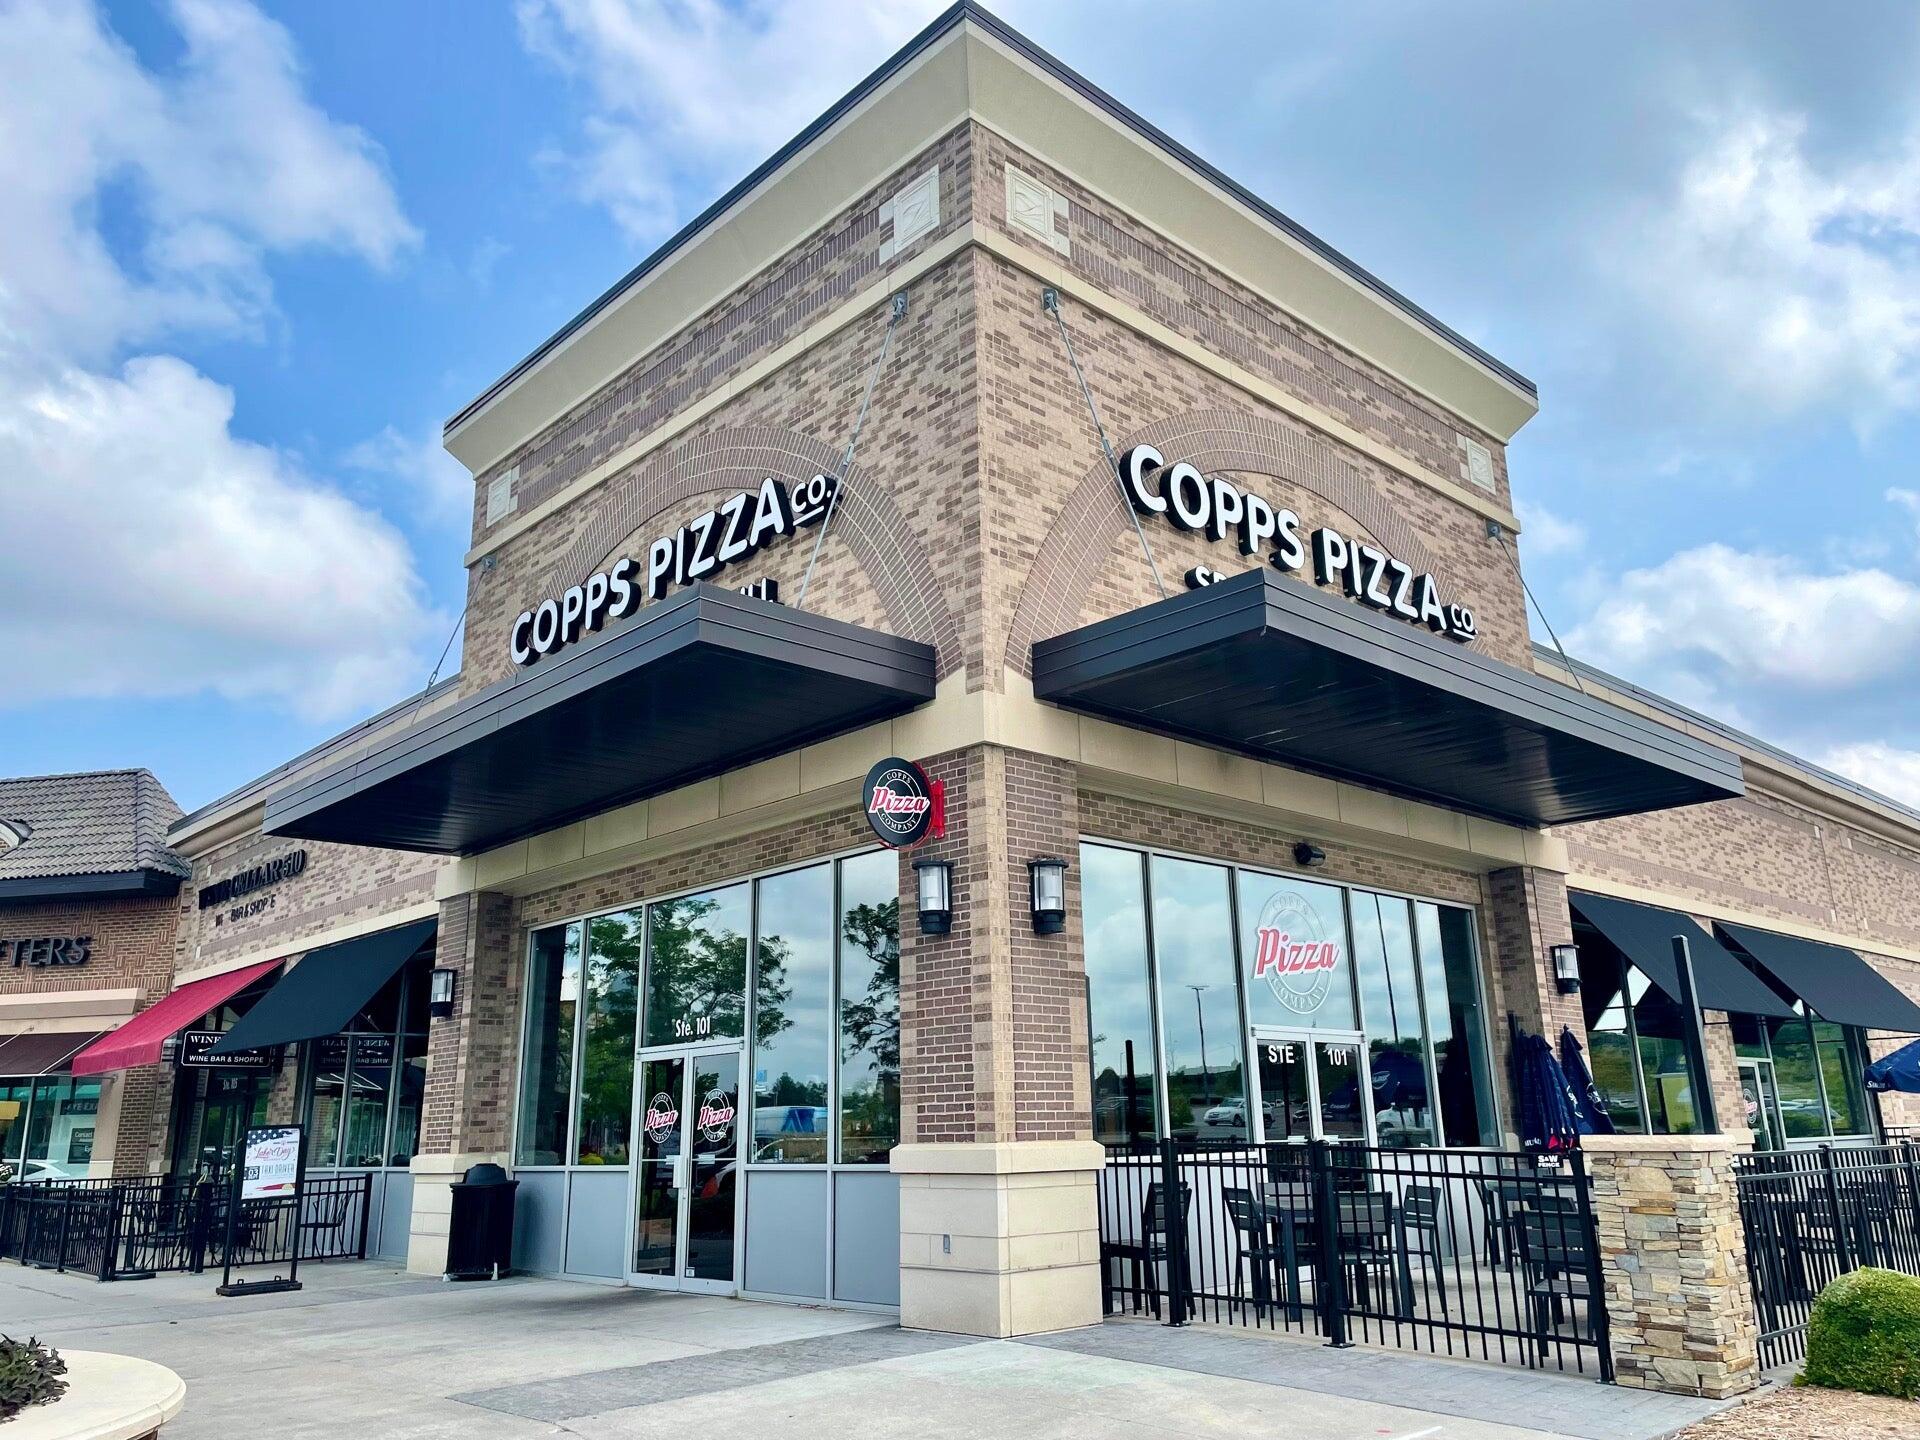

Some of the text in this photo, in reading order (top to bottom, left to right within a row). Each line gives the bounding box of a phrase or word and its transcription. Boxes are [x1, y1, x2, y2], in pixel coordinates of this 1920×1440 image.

[1129, 444, 1306, 570] COPPS
[1320, 527, 1447, 630] PIZZA
[510, 474, 833, 665] COPPS PIZZA CO.
[886, 771, 911, 784] COPPS
[868, 786, 931, 813] Pizza
[880, 813, 917, 831] COMPANY
[0, 935, 91, 966] TERS
[1254, 927, 1339, 979] Pizza
[675, 1016, 711, 1037] Ste. 101
[1268, 1045, 1348, 1066] STE 101
[644, 1109, 679, 1131] Pizza
[697, 1106, 735, 1130] Pizza
